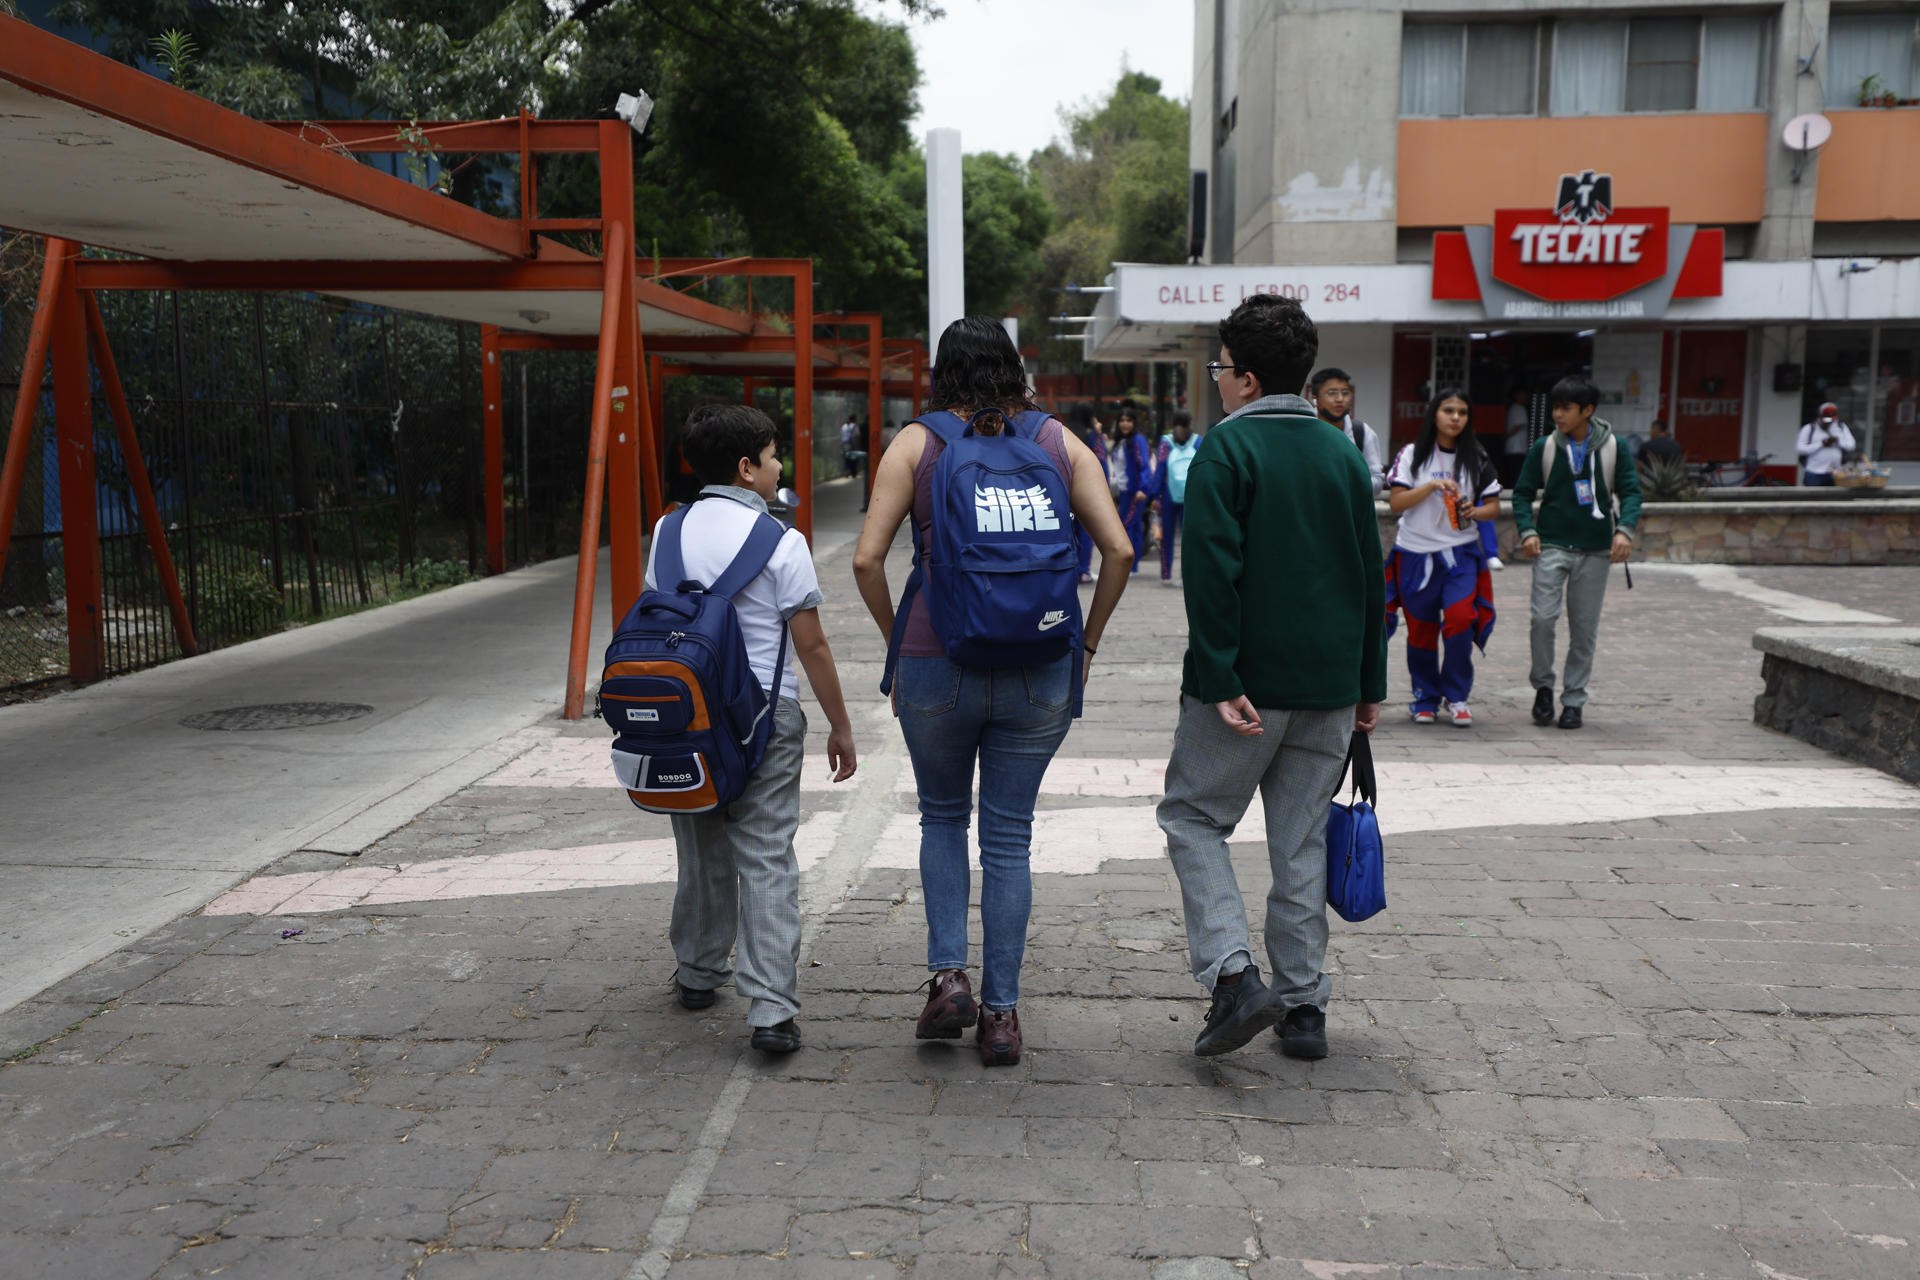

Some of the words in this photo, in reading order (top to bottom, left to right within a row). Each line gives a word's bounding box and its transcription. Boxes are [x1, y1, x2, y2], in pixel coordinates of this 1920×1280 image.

[1510, 223, 1649, 264] TECATE
[1158, 284, 1225, 304] CALLE
[1323, 283, 1361, 303] 284
[1398, 402, 1426, 418] TEC
[1679, 398, 1741, 417] TECATE
[975, 483, 1061, 532] NIKE
[1043, 610, 1065, 623] NIKE
